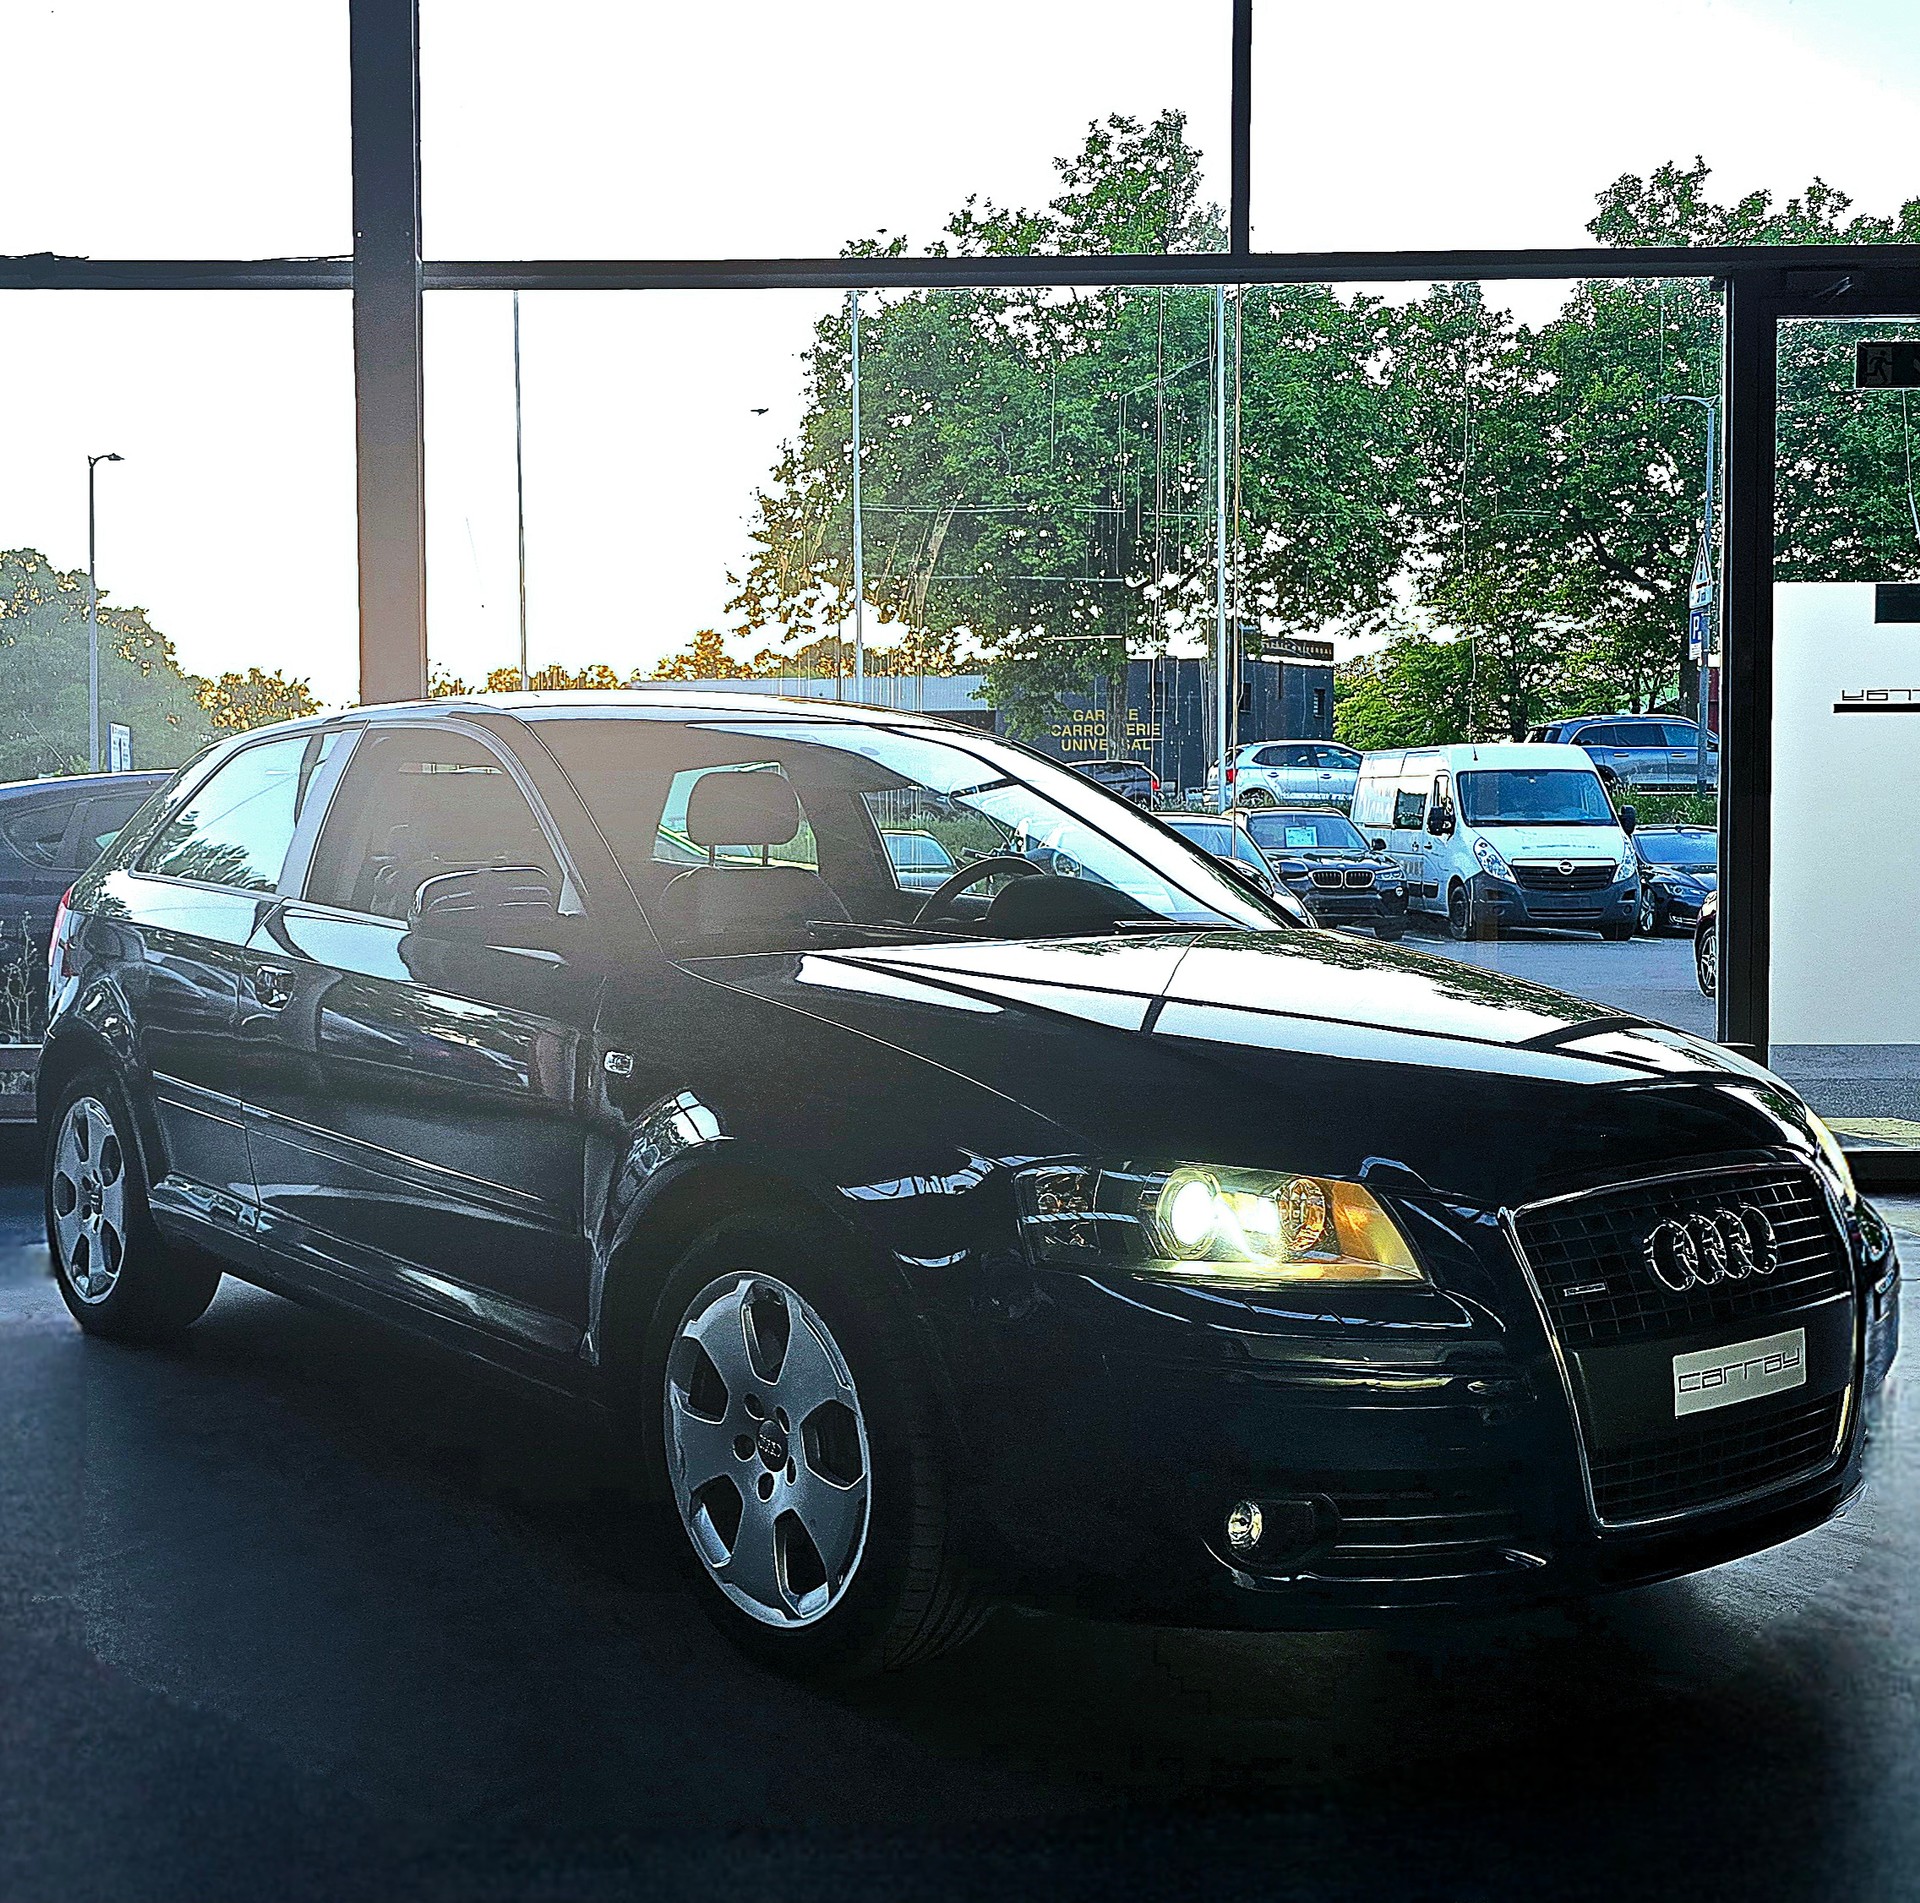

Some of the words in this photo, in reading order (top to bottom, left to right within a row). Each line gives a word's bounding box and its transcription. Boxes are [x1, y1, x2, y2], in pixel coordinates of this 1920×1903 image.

[1073, 709, 1138, 721] GARE
[1051, 723, 1161, 737] CARROERIE
[1061, 738, 1151, 751] UNIVEAL
[1678, 1347, 1800, 1393] carray
